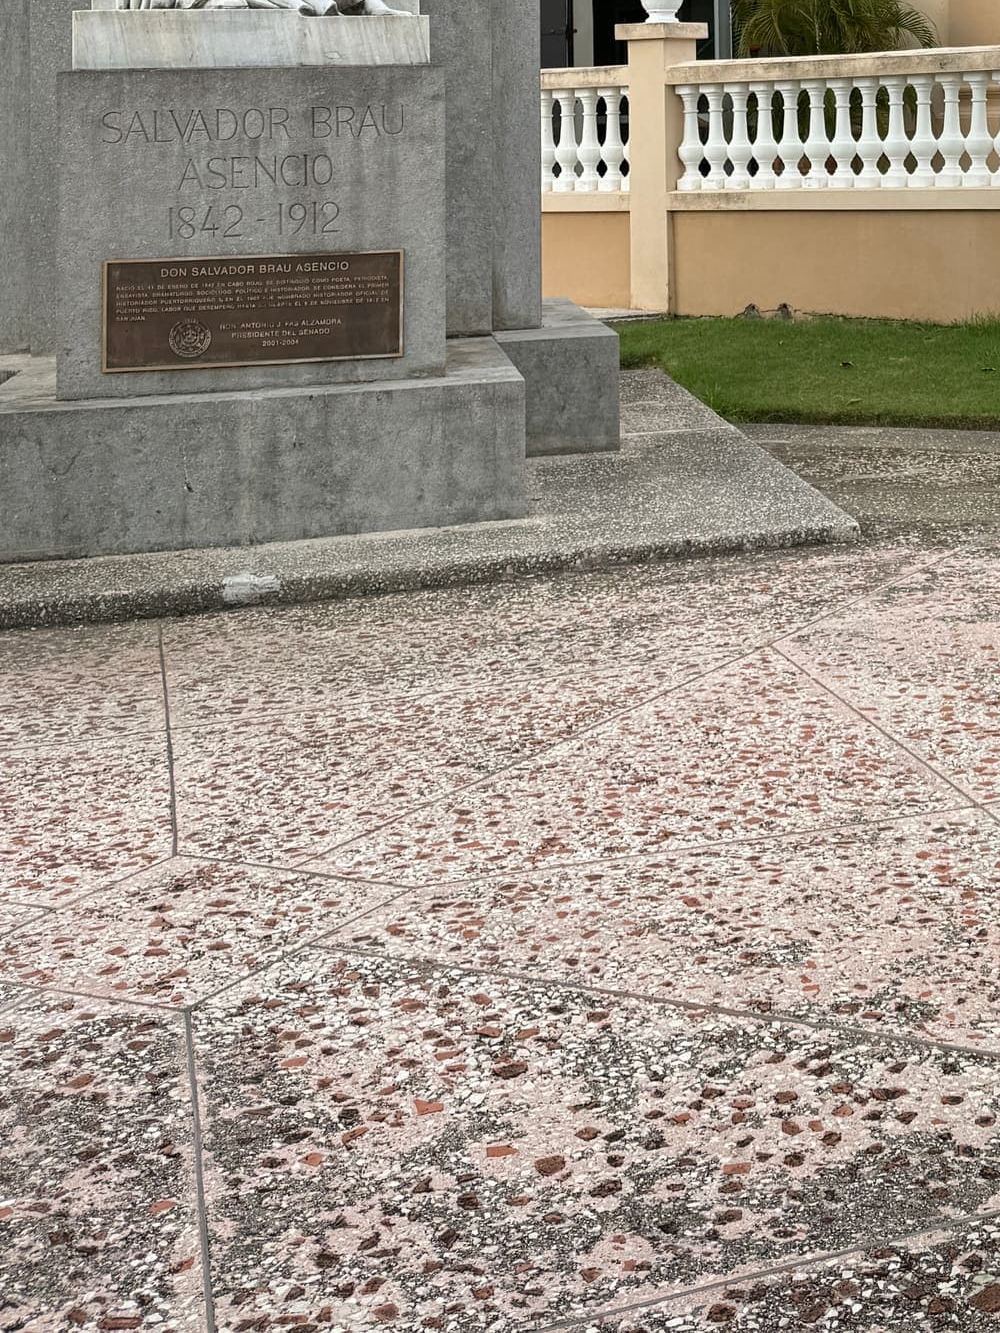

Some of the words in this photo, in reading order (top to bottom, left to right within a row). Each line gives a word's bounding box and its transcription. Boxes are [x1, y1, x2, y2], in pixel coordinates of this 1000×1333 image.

[102, 108, 292, 144] SALVADOR
[311, 104, 404, 139] BRAU
[178, 154, 333, 191] ASENCIO
[160, 268, 187, 278] DON
[191, 265, 255, 277] SALVADOR
[259, 263, 292, 274] BRAU
[296, 261, 350, 273] ASENCIO
[301, 318, 342, 327] ALZAMORA
[299, 328, 330, 336] SENADO
